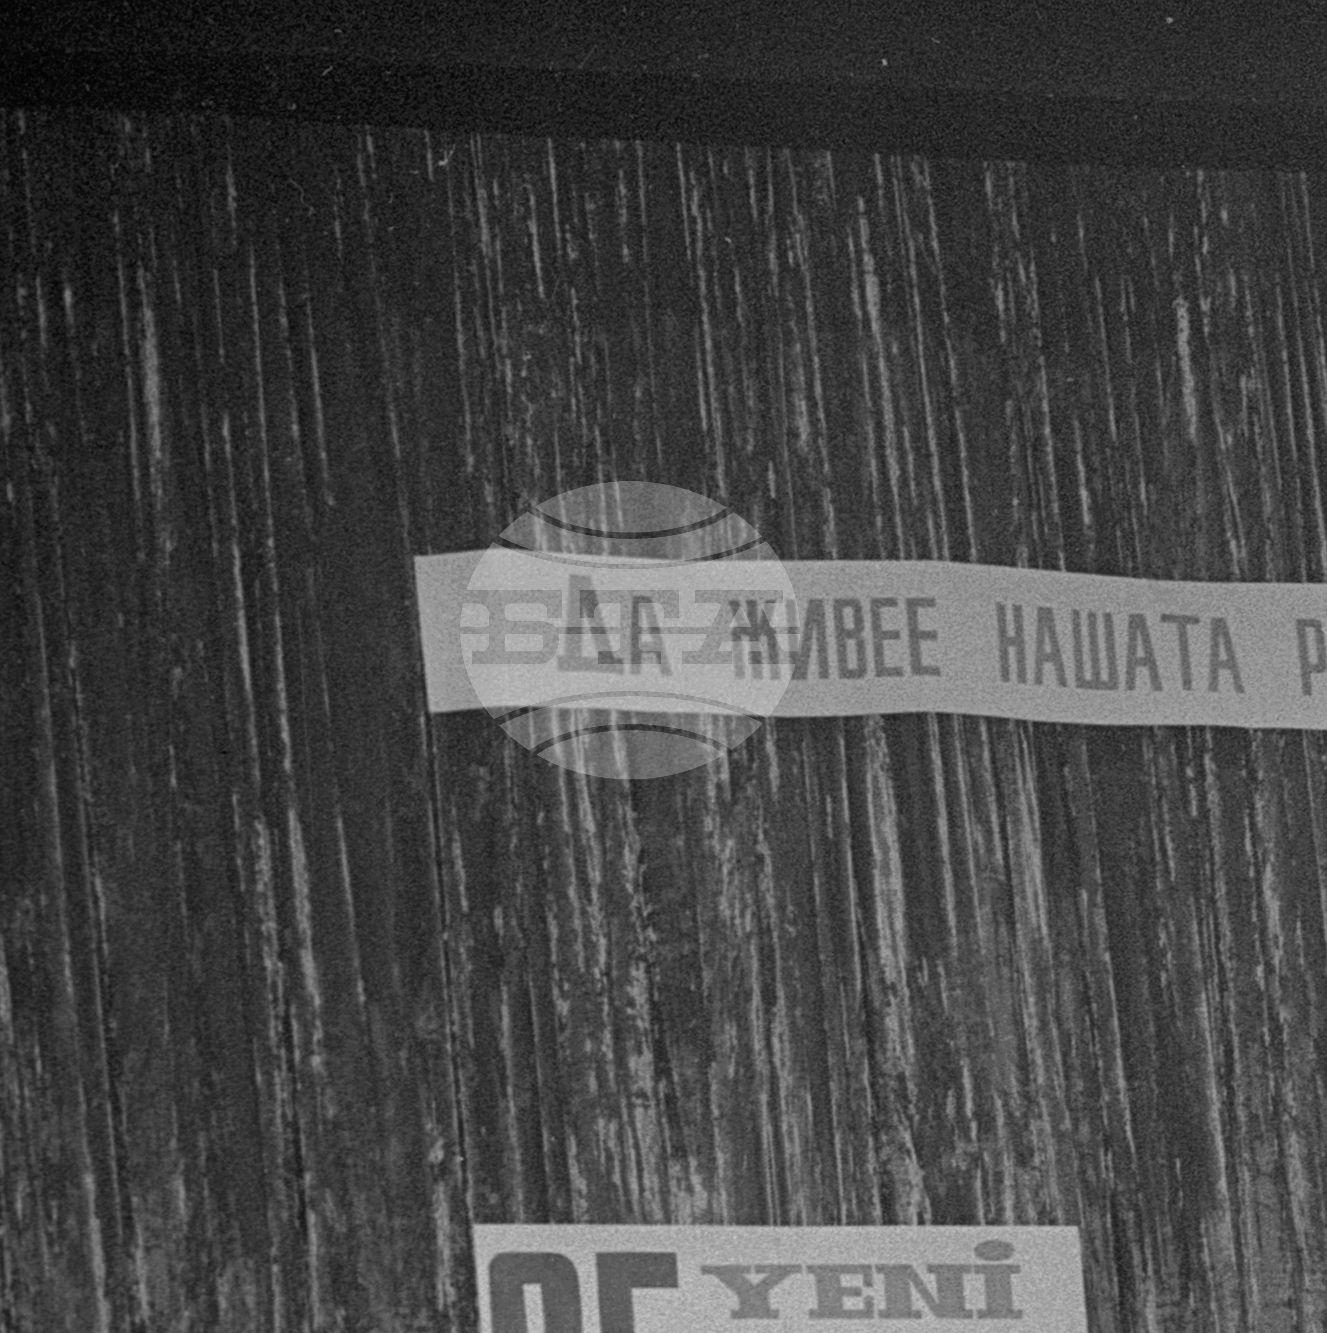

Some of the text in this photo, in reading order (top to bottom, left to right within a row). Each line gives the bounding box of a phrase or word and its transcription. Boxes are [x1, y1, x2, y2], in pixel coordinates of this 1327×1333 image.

[556, 573, 673, 677] ДА
[729, 596, 942, 681] ЖИВЕЕ
[995, 603, 1245, 694] НАШАТА
